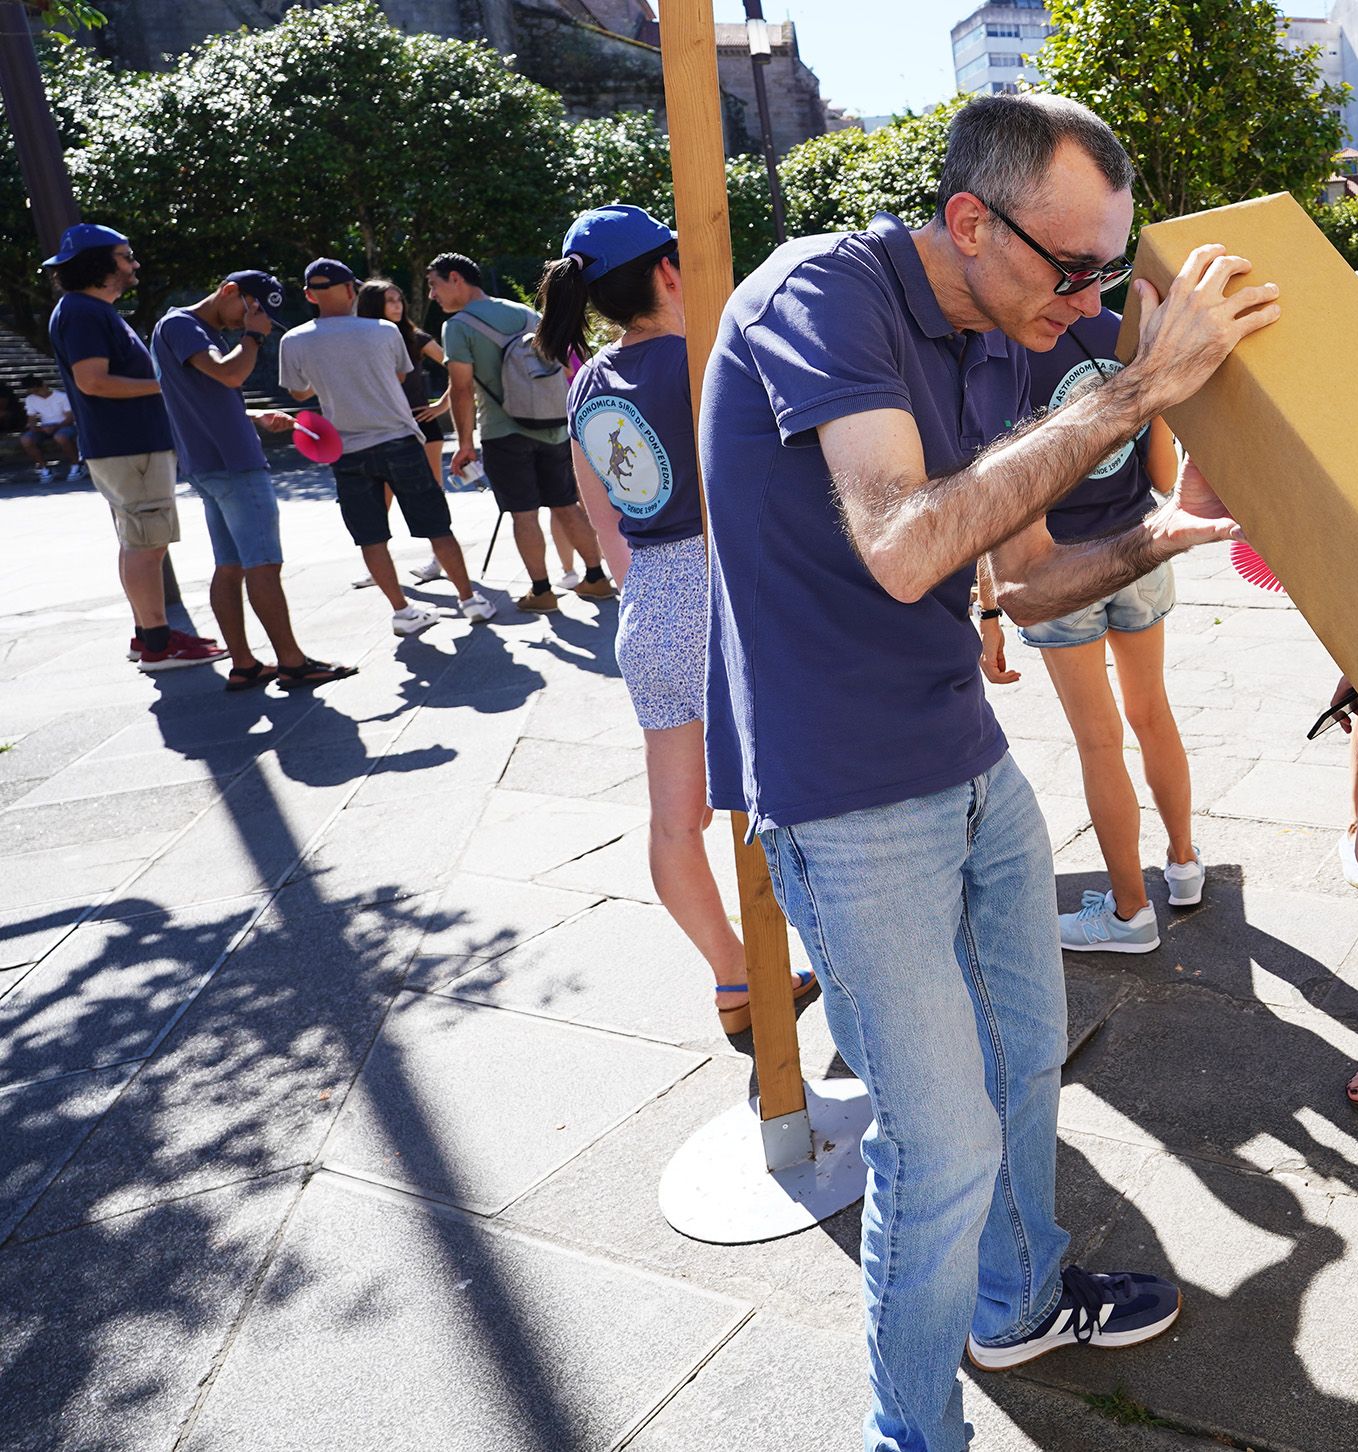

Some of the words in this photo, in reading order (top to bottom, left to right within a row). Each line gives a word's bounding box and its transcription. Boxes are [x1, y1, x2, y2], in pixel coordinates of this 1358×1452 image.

[618, 401, 636, 417] SIRIO
[634, 416, 645, 429] DE
[644, 429, 670, 490] PONTEVEDRA
[1108, 457, 1121, 472] 1999
[644, 503, 658, 514] 1999
